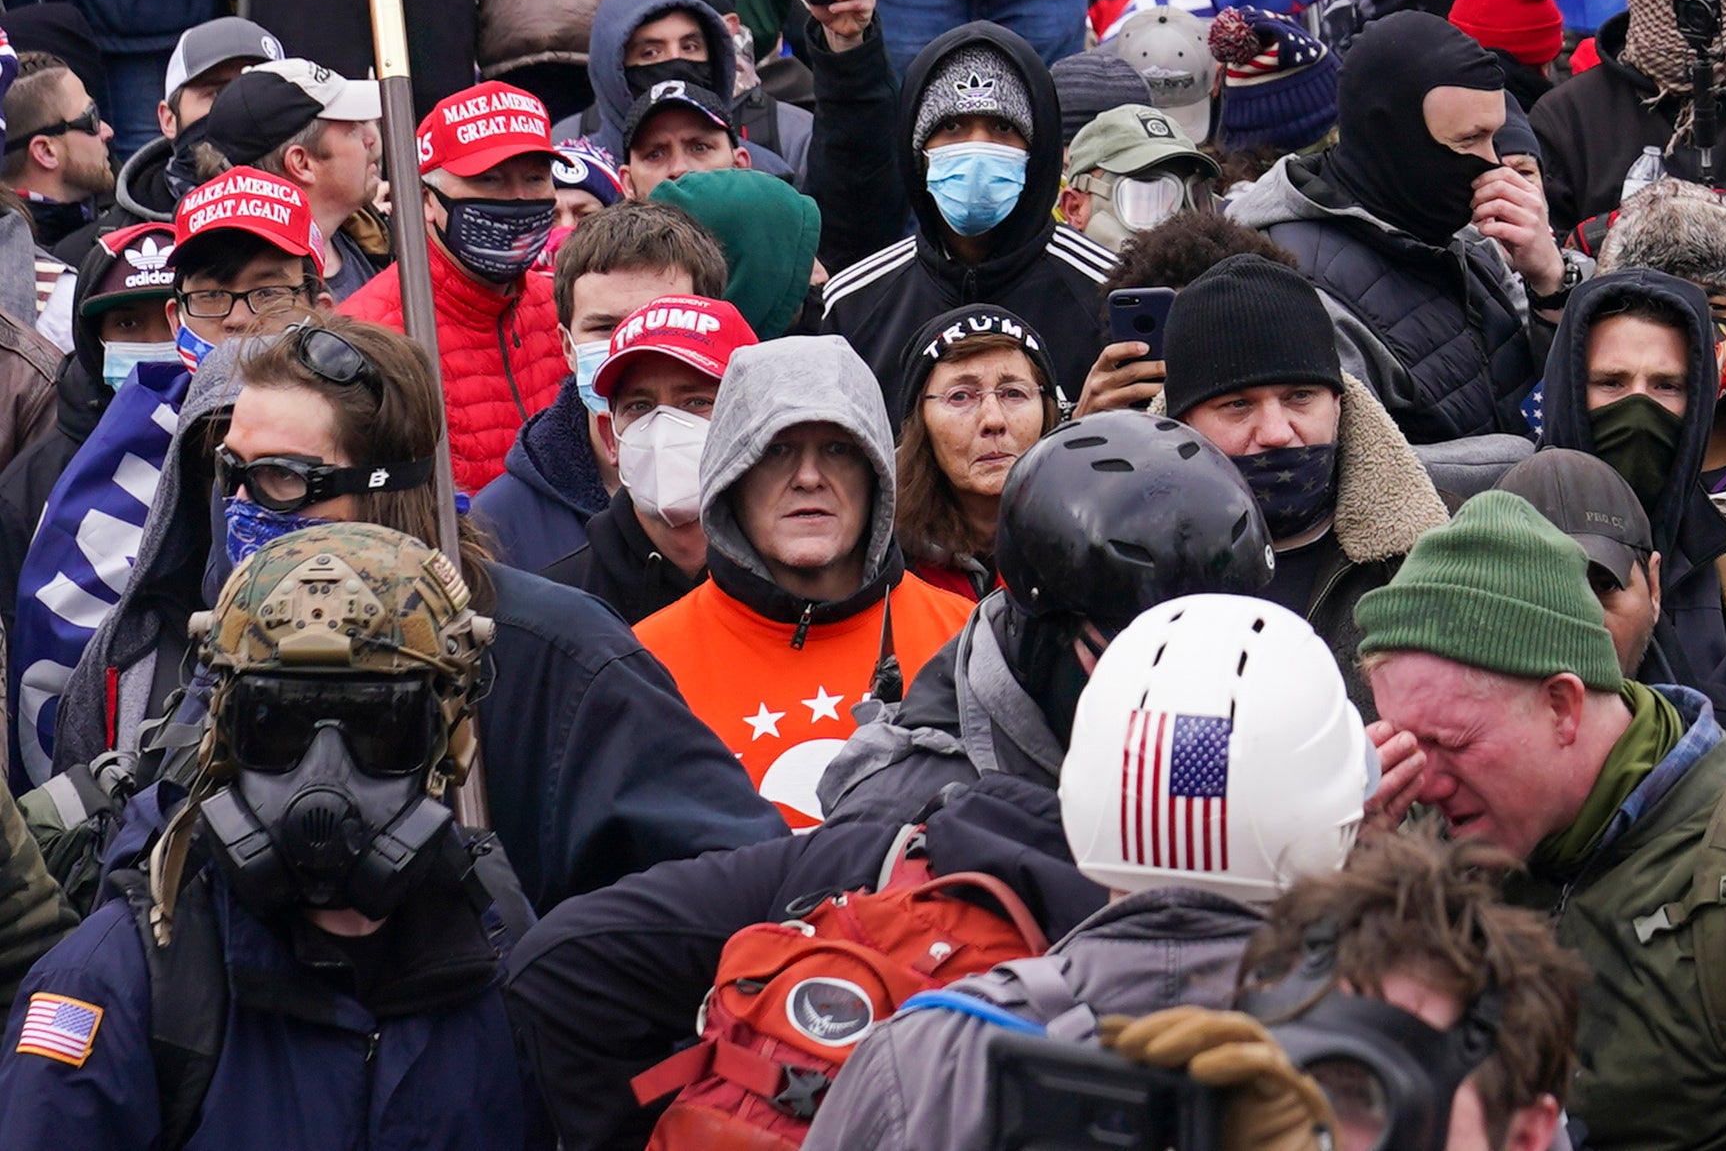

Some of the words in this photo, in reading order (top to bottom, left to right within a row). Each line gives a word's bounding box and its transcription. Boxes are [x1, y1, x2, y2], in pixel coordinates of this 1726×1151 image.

[442, 95, 489, 125] MAKE
[490, 92, 547, 118] AMERICA
[456, 115, 508, 145] GREAT
[509, 115, 547, 138] AGAIN
[182, 180, 224, 215] MAKE
[222, 175, 302, 207] AMERICA
[189, 201, 236, 233] GREAT
[236, 198, 292, 226] AGAIN
[615, 308, 720, 350] TRUMP
[923, 315, 1039, 359] TRUMP
